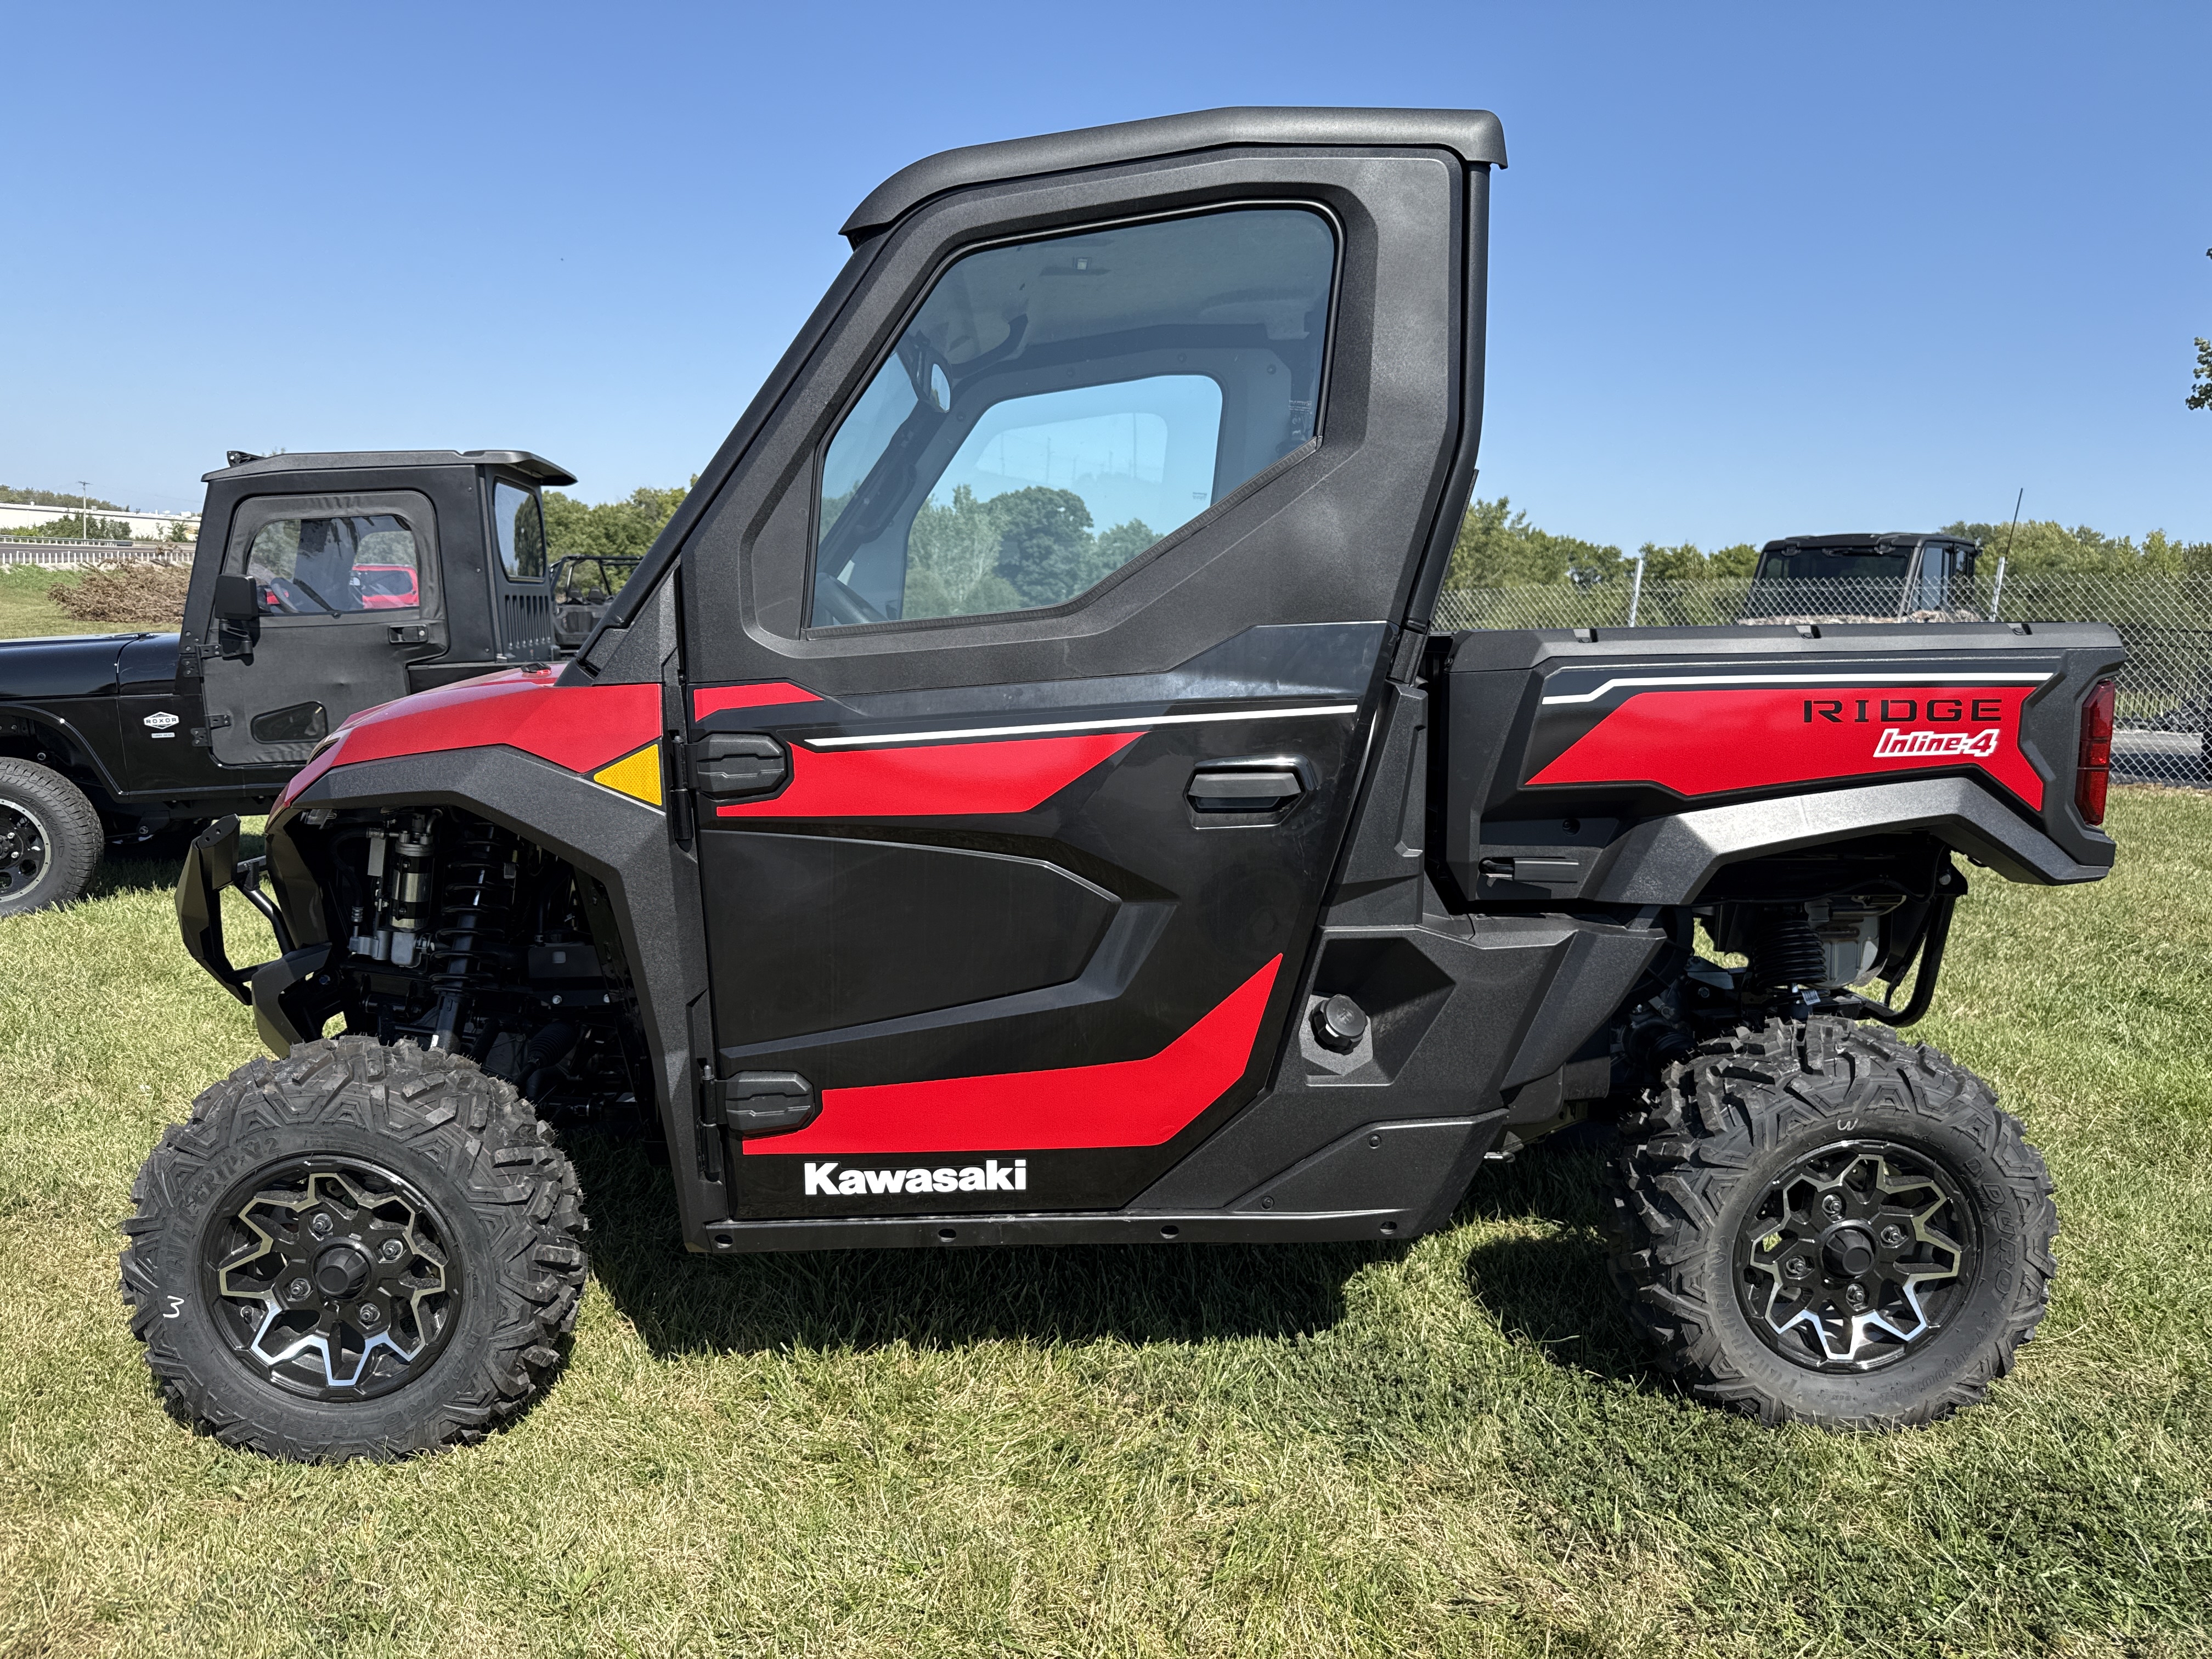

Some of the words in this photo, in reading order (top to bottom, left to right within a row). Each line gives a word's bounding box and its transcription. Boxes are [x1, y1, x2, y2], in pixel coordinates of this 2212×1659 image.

[1803, 698, 2003, 723] RIDGE
[1875, 730, 1998, 756] Inline-4
[804, 1159, 1026, 1195] Kawasaki
[1982, 1183, 2017, 1294] DURO
